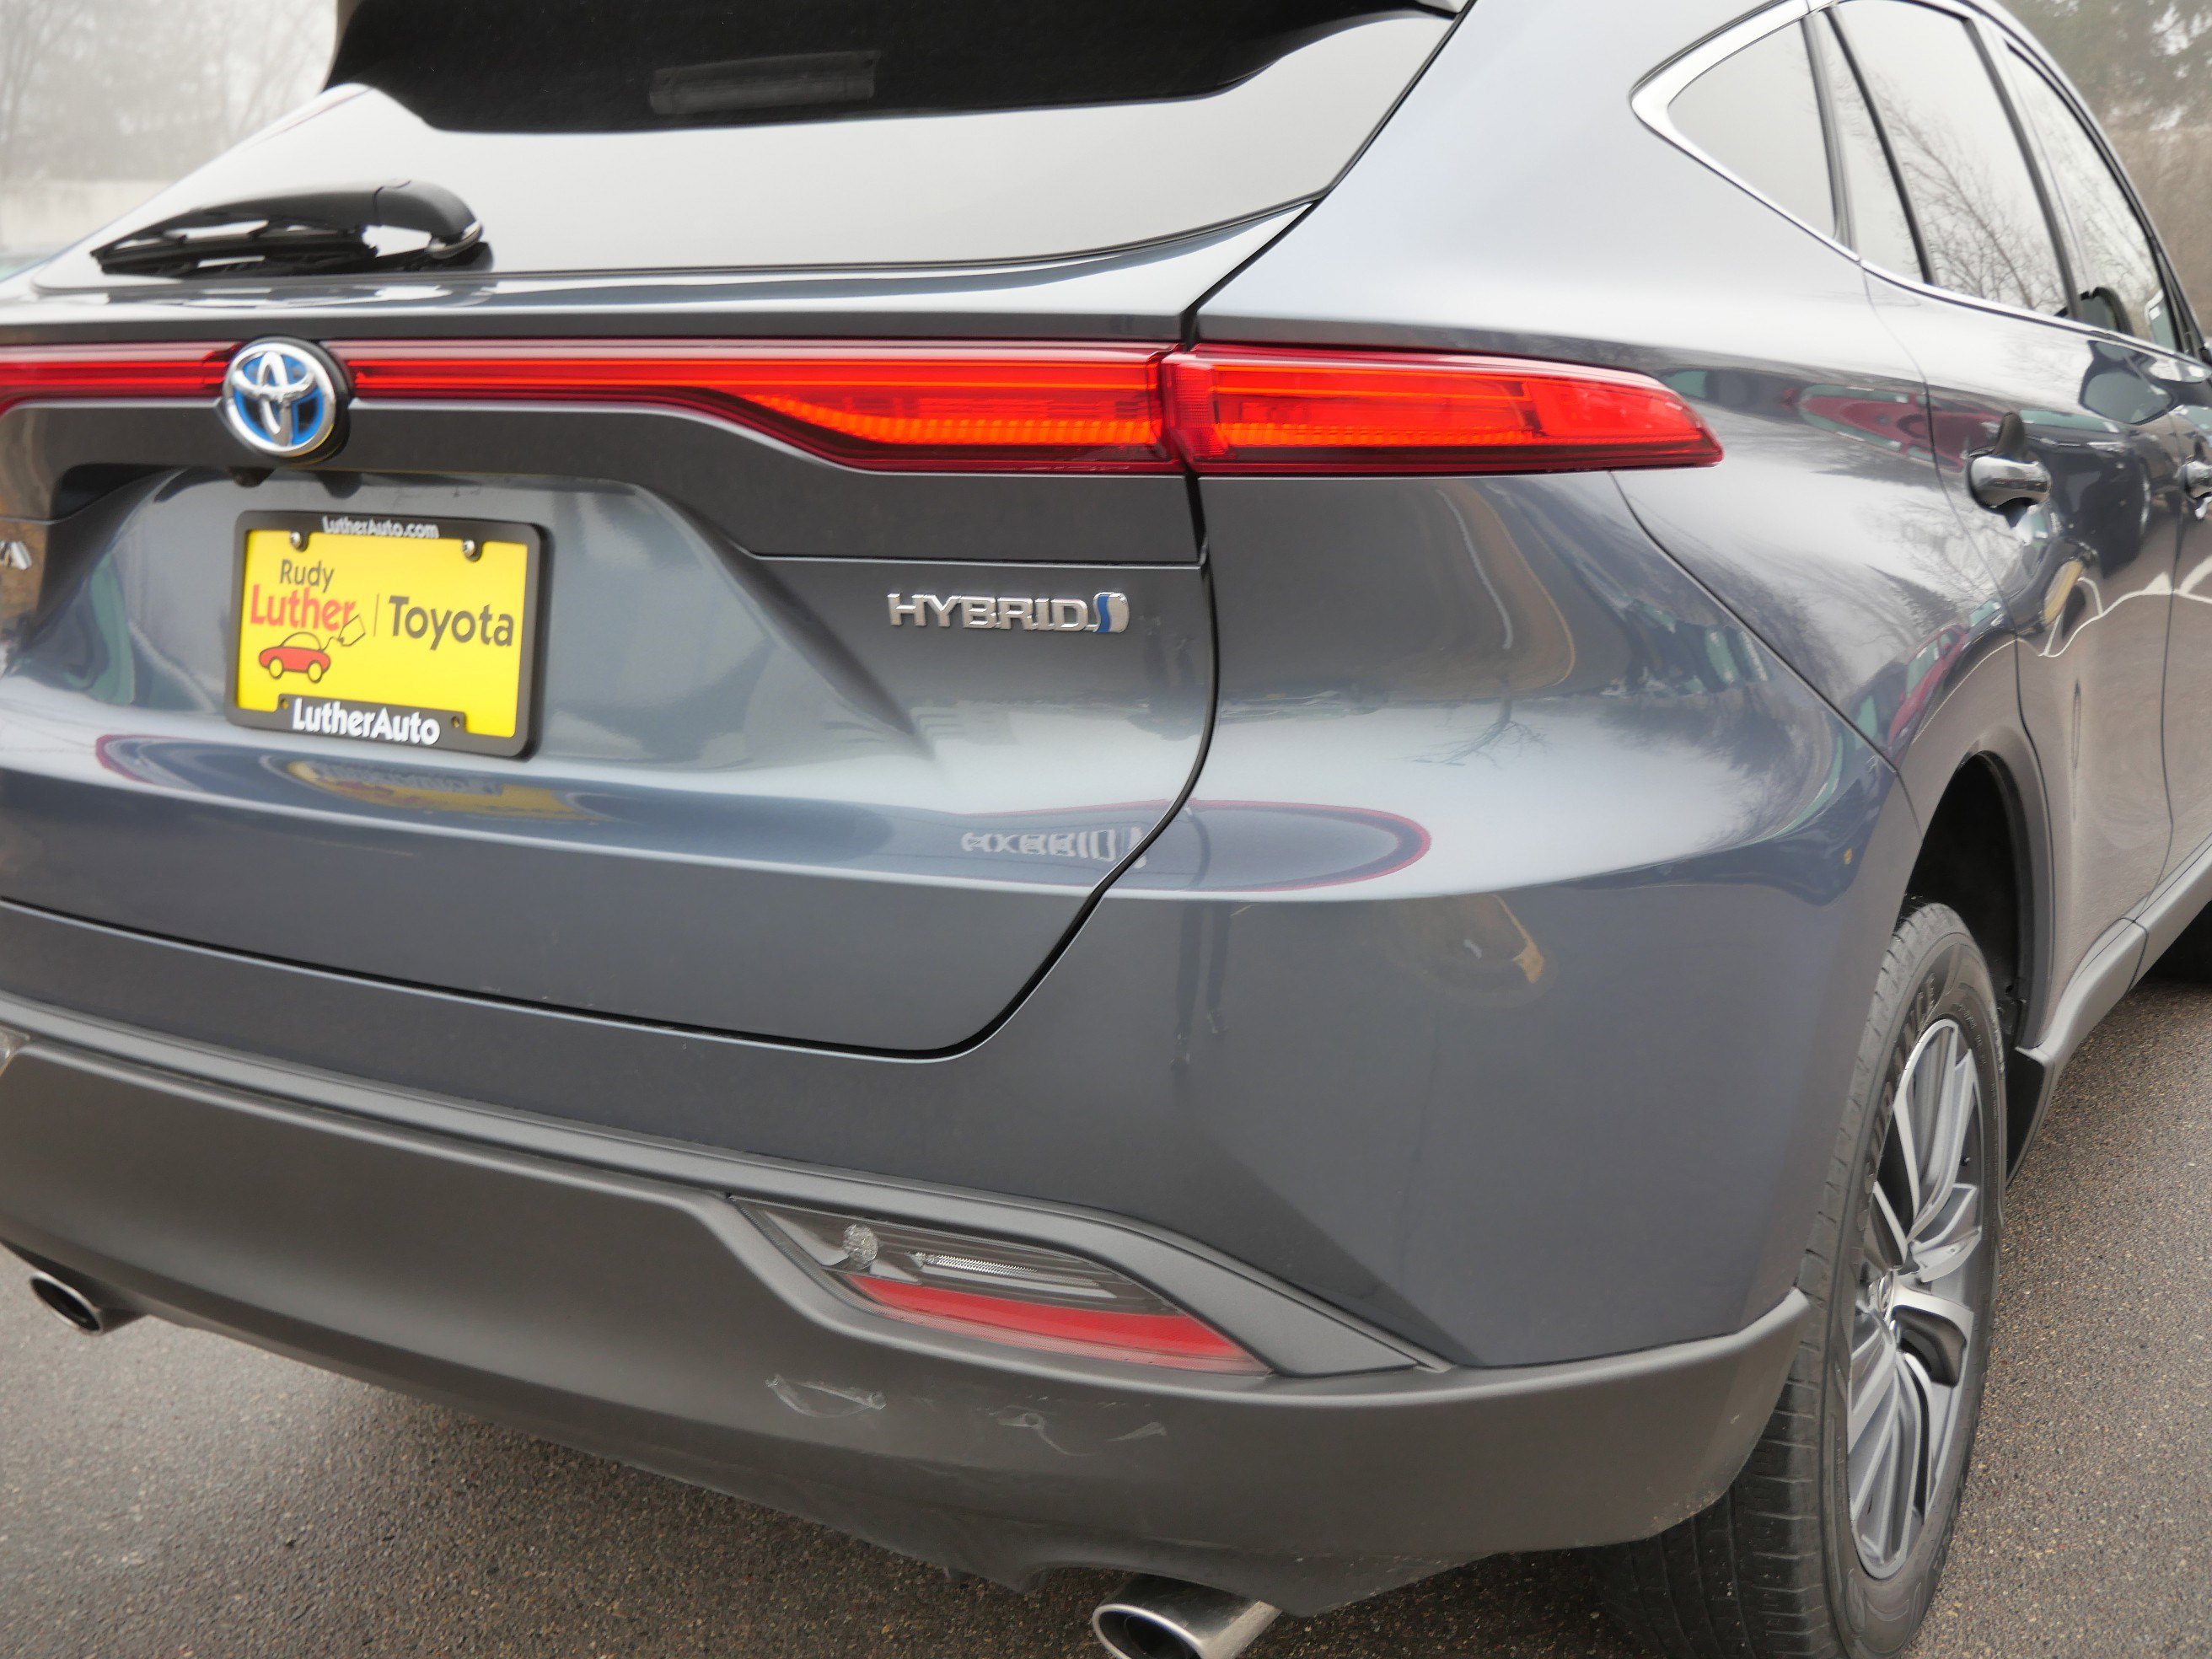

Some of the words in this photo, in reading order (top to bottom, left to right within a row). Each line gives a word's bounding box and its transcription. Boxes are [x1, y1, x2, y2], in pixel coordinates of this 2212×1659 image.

[322, 516, 439, 539] LutherAuto.com
[280, 559, 335, 593] Rudy
[250, 585, 356, 631] Luther
[389, 596, 515, 651] Toyota
[888, 593, 1088, 631] HYBRID
[292, 698, 440, 746] LutherAuto
